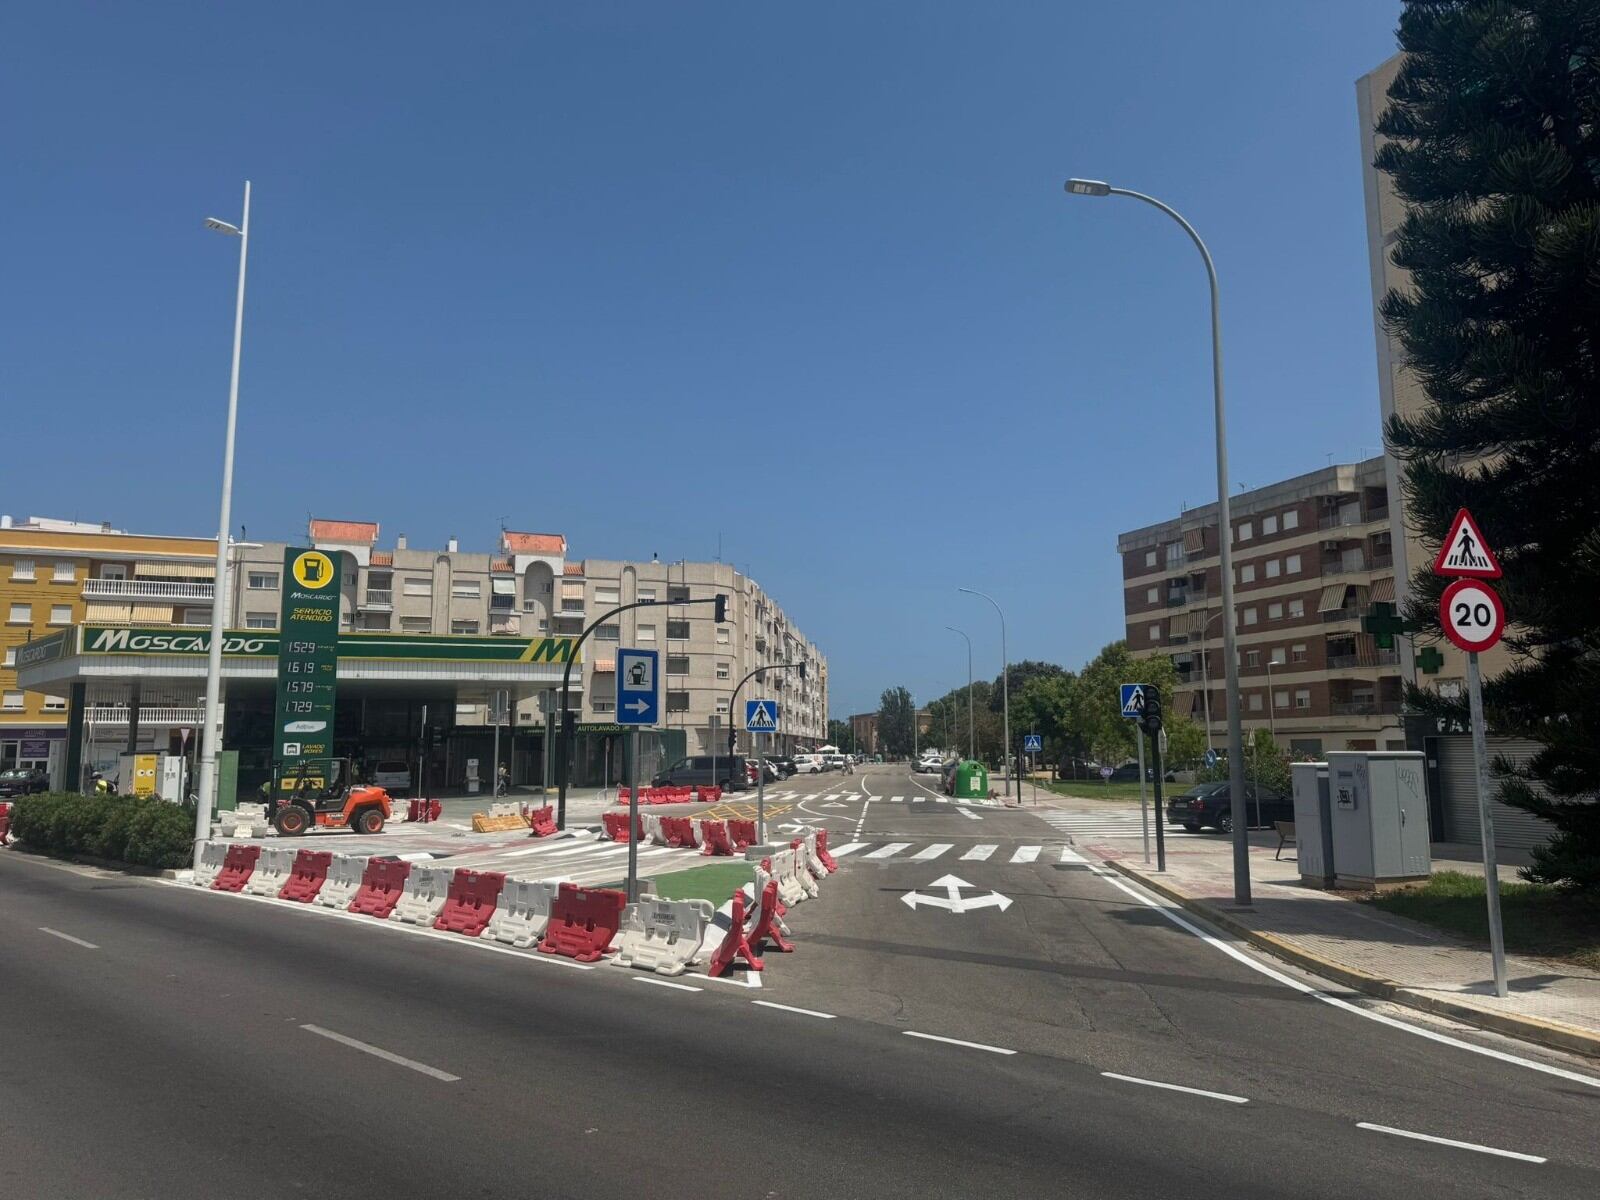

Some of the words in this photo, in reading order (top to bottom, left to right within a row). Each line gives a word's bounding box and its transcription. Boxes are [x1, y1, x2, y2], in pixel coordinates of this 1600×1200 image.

[293, 607, 332, 616] SERVICIO
[1455, 602, 1491, 627] 20
[290, 614, 333, 622] ATENDIDO
[530, 638, 573, 662] M
[577, 724, 620, 732] AUTOLAVADO
